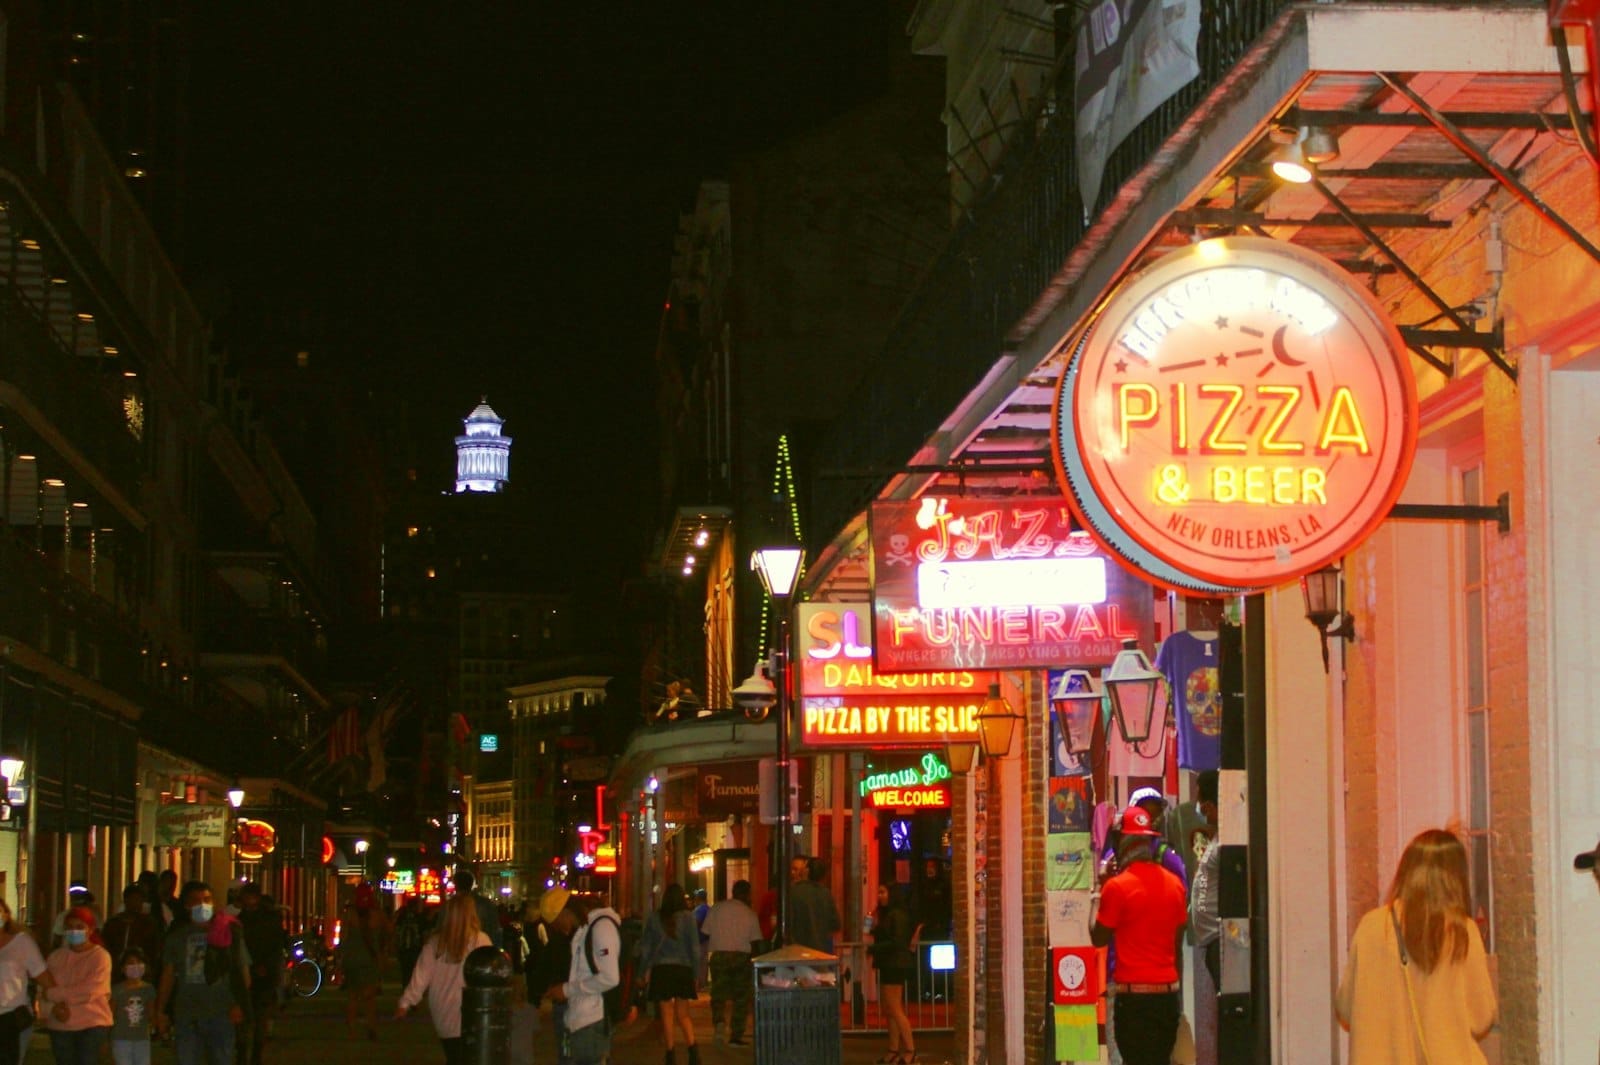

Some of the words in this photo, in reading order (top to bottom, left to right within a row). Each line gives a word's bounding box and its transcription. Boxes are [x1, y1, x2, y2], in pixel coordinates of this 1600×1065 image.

[1112, 382, 1371, 457] PIZZA
[1153, 464, 1190, 505] &
[1211, 464, 1327, 505] BEER
[1167, 511, 1207, 544] NEW
[1212, 525, 1299, 550] ORLEANS,
[1300, 514, 1323, 535] LA
[891, 603, 1138, 647] FUNERAL
[892, 646, 937, 665] WHERE
[1018, 643, 1060, 660] DYING
[1064, 643, 1081, 658] TO
[824, 664, 975, 688] DAIQUIRIS
[805, 707, 862, 734] PIZZA
[865, 707, 890, 733] BY
[895, 706, 931, 733] THE
[935, 705, 980, 733] SLIC
[873, 789, 945, 806] WELCOME
